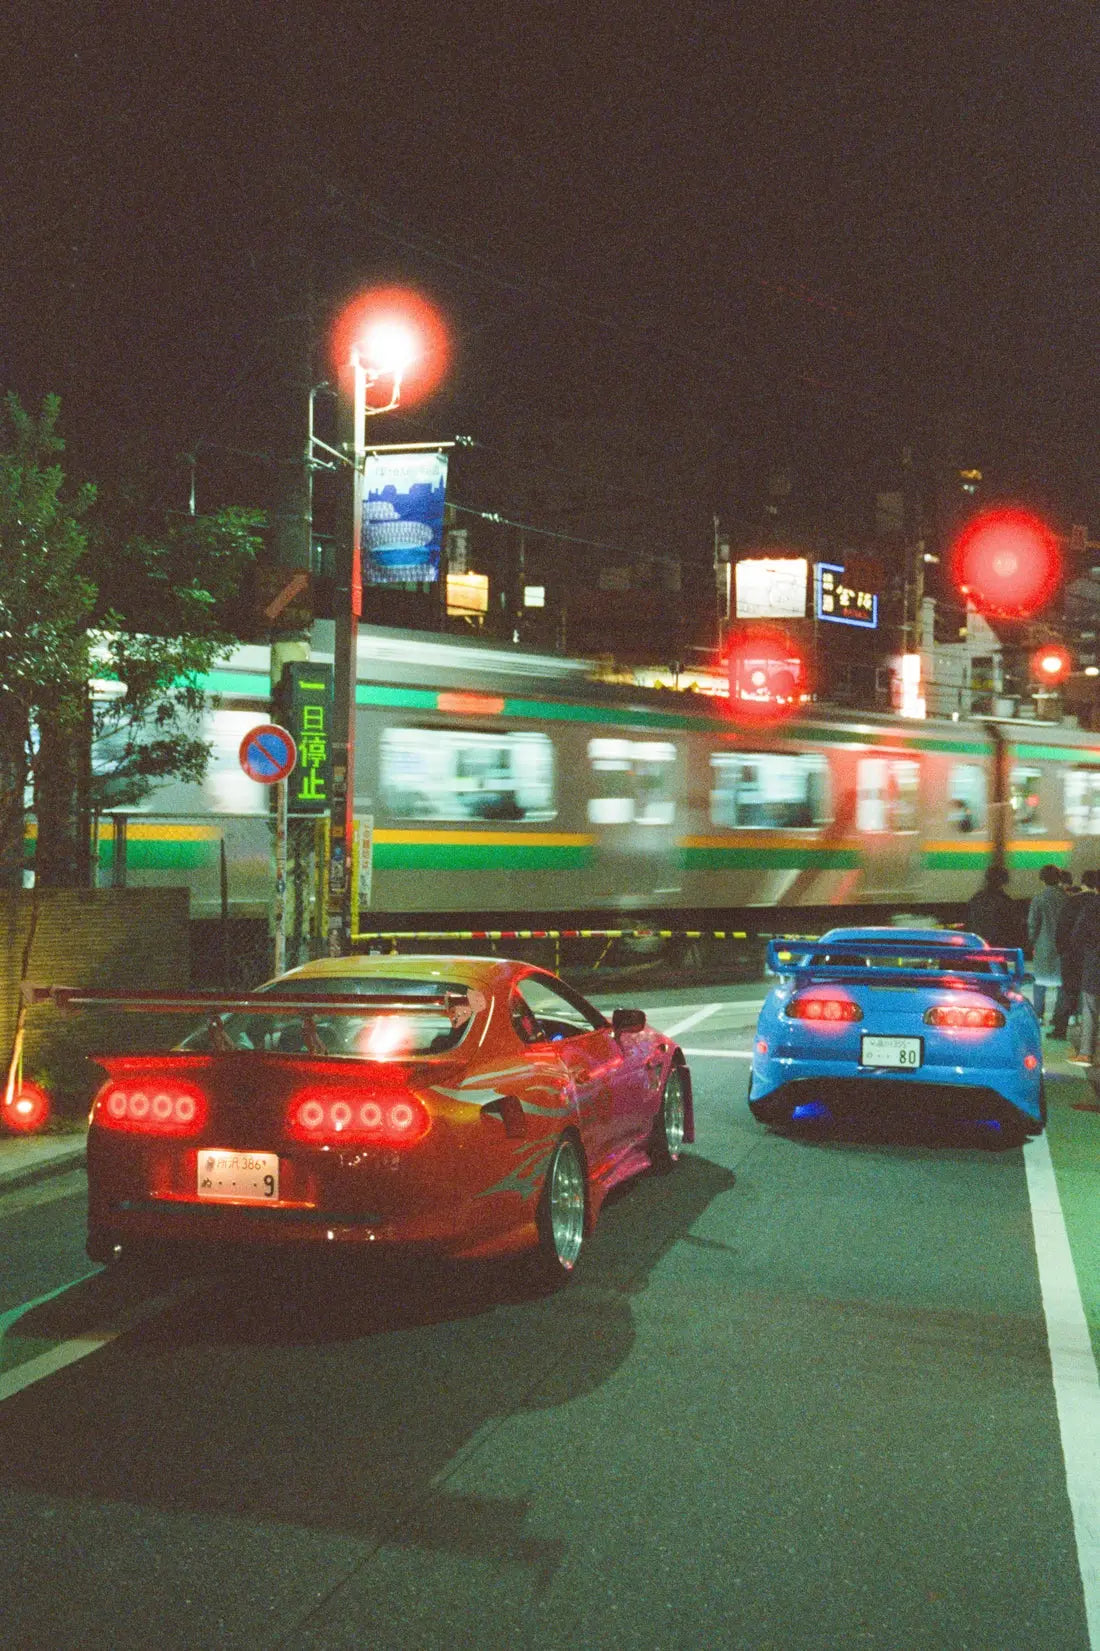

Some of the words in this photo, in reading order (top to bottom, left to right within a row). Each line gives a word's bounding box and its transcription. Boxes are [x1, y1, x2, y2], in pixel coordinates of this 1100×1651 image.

[298, 681, 328, 800] 一旦停止
[899, 1050, 917, 1065] 80
[241, 1158, 261, 1170] 386
[263, 1174, 275, 1198] 9
